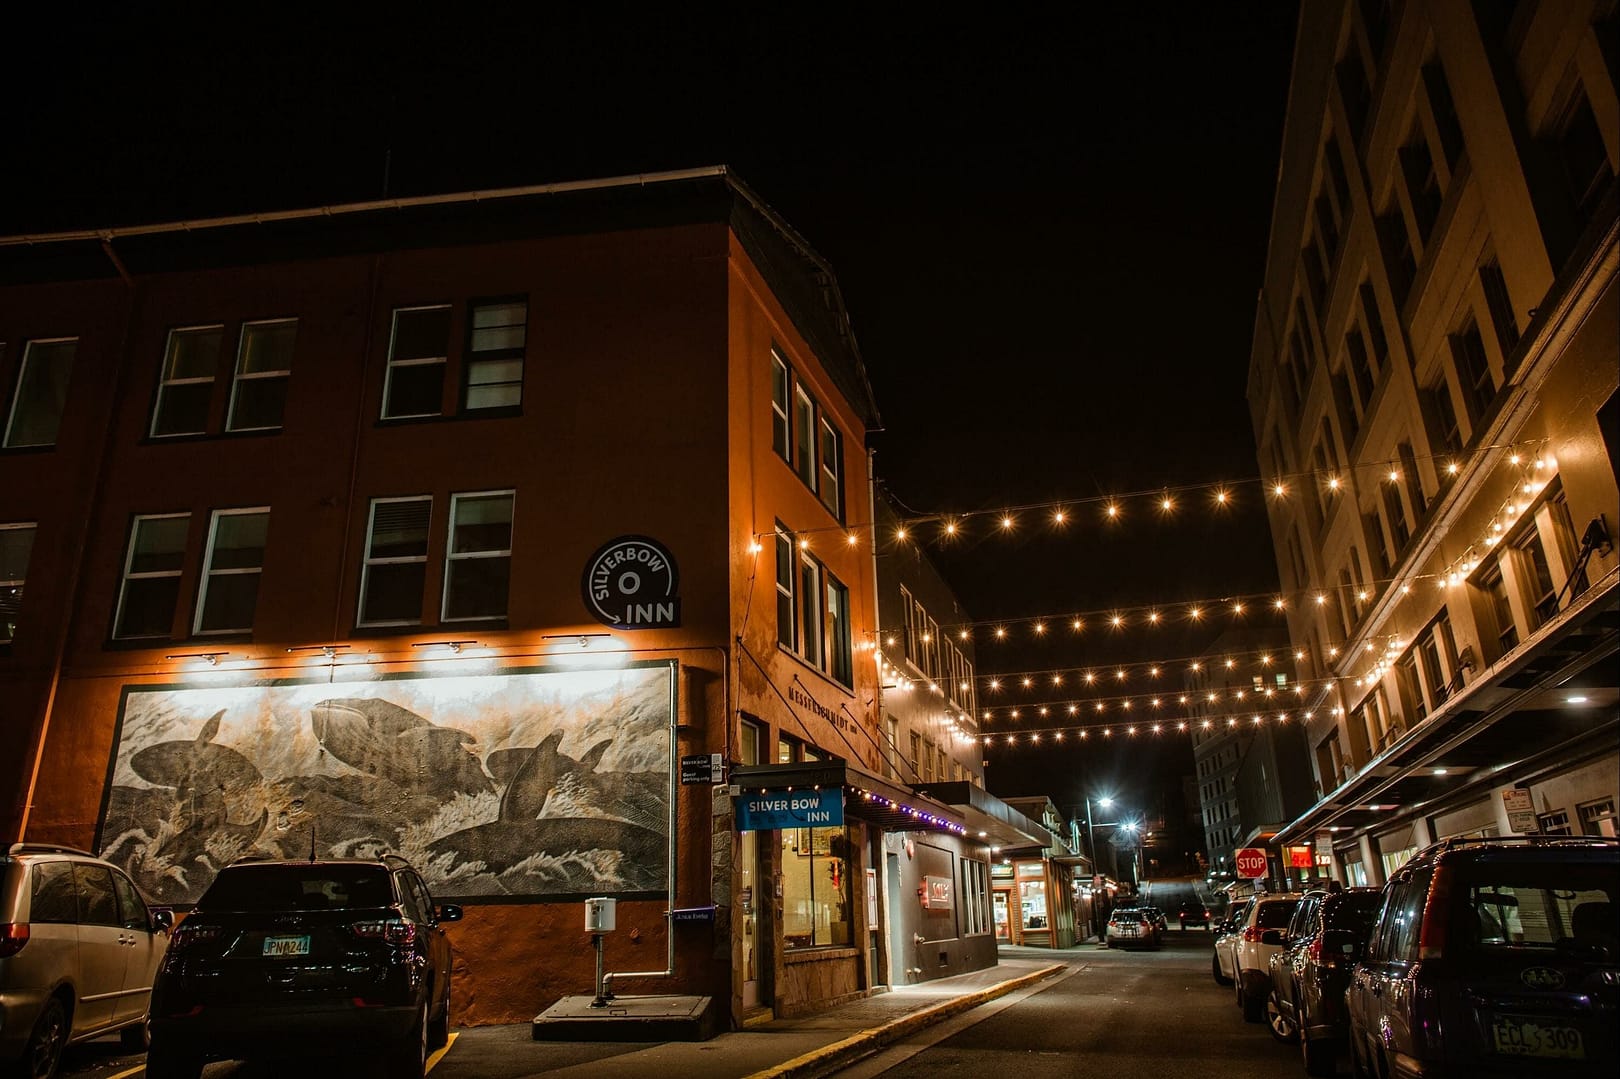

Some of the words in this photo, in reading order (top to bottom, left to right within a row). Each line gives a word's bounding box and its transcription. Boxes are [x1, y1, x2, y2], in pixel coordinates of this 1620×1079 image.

[594, 548, 665, 600] SILVERBOW
[627, 602, 673, 624] INN
[749, 801, 788, 813] SILVER
[791, 798, 819, 810] BOW
[808, 811, 829, 823] INN
[1238, 857, 1264, 870] STOP
